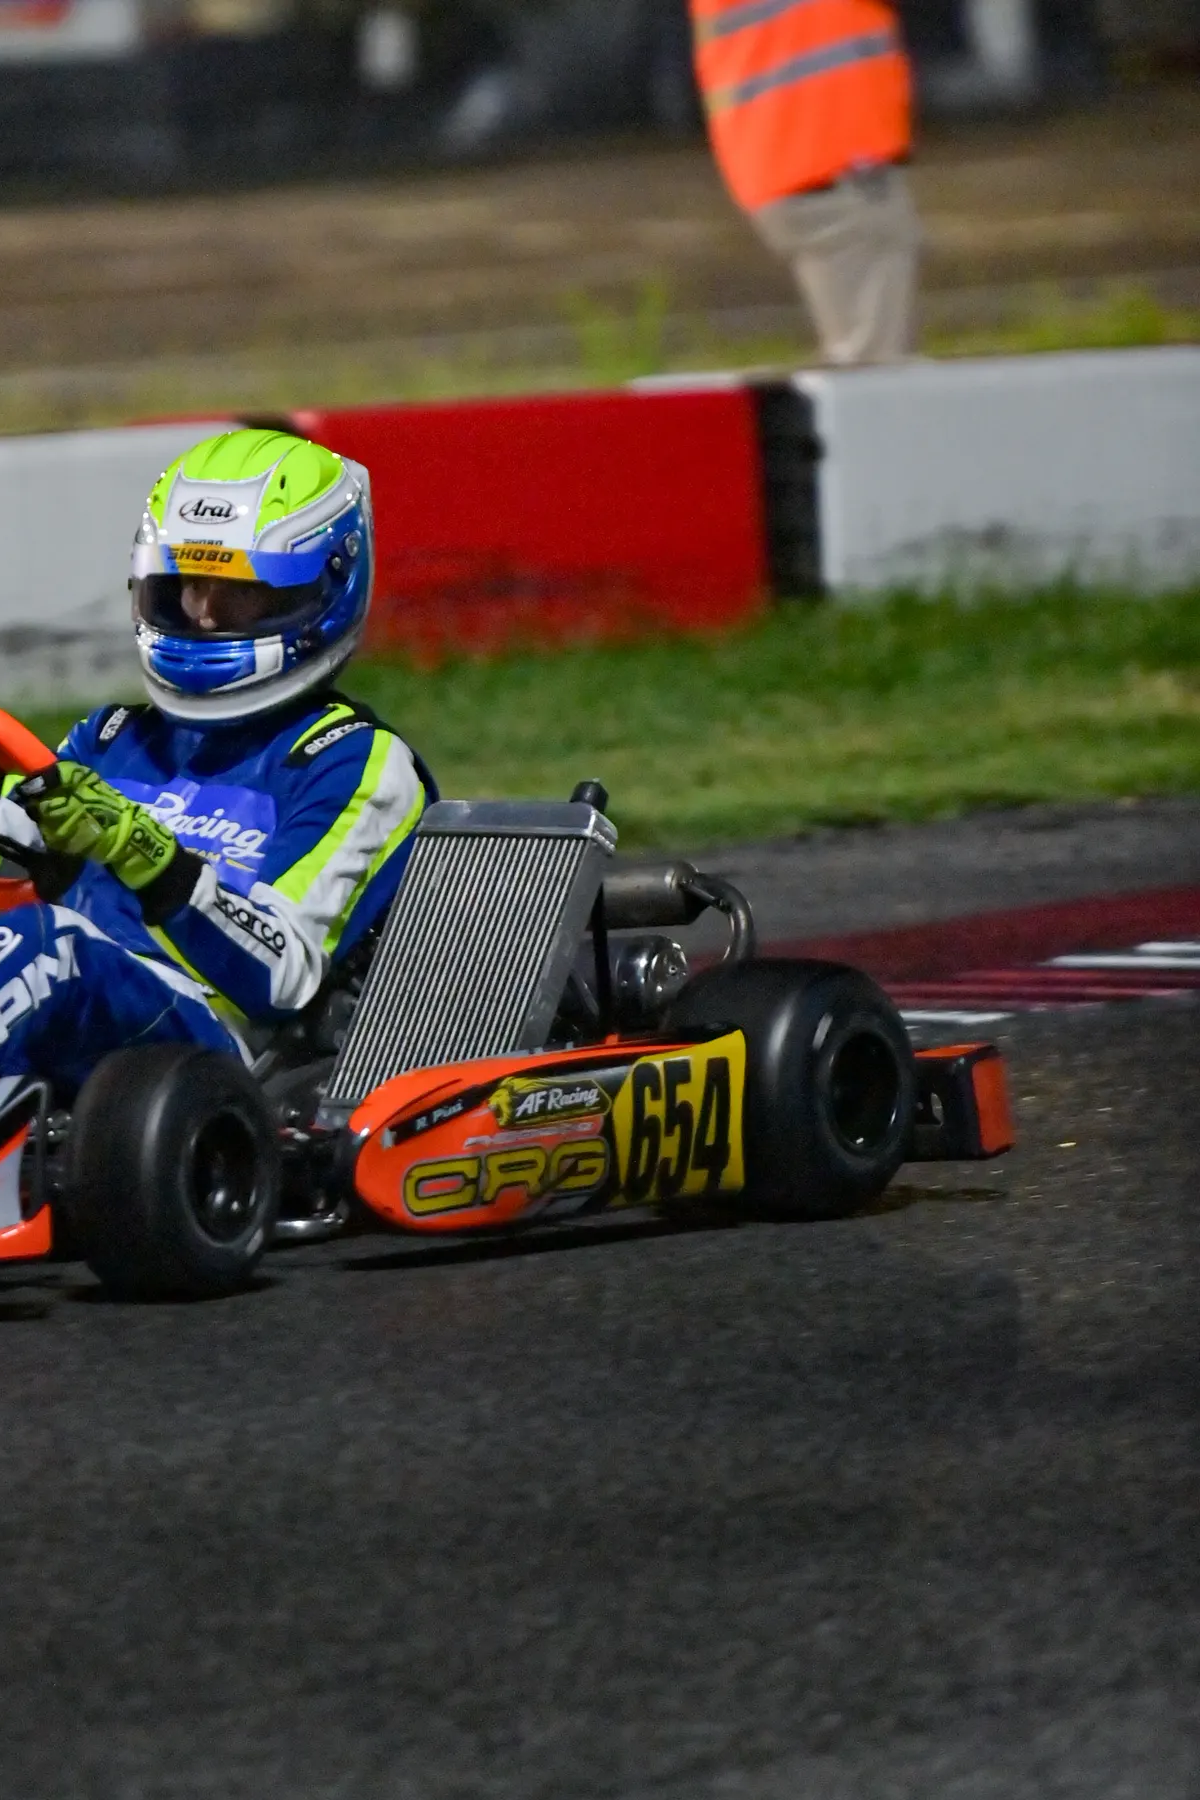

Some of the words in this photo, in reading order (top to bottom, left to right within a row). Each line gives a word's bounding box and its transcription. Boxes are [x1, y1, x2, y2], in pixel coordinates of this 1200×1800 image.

[181, 499, 232, 518] Arai
[145, 791, 268, 858] Racing
[515, 1090, 547, 1117] AF
[548, 1086, 600, 1110] Racing
[623, 1056, 731, 1199] 654
[403, 1137, 608, 1218] CRG
